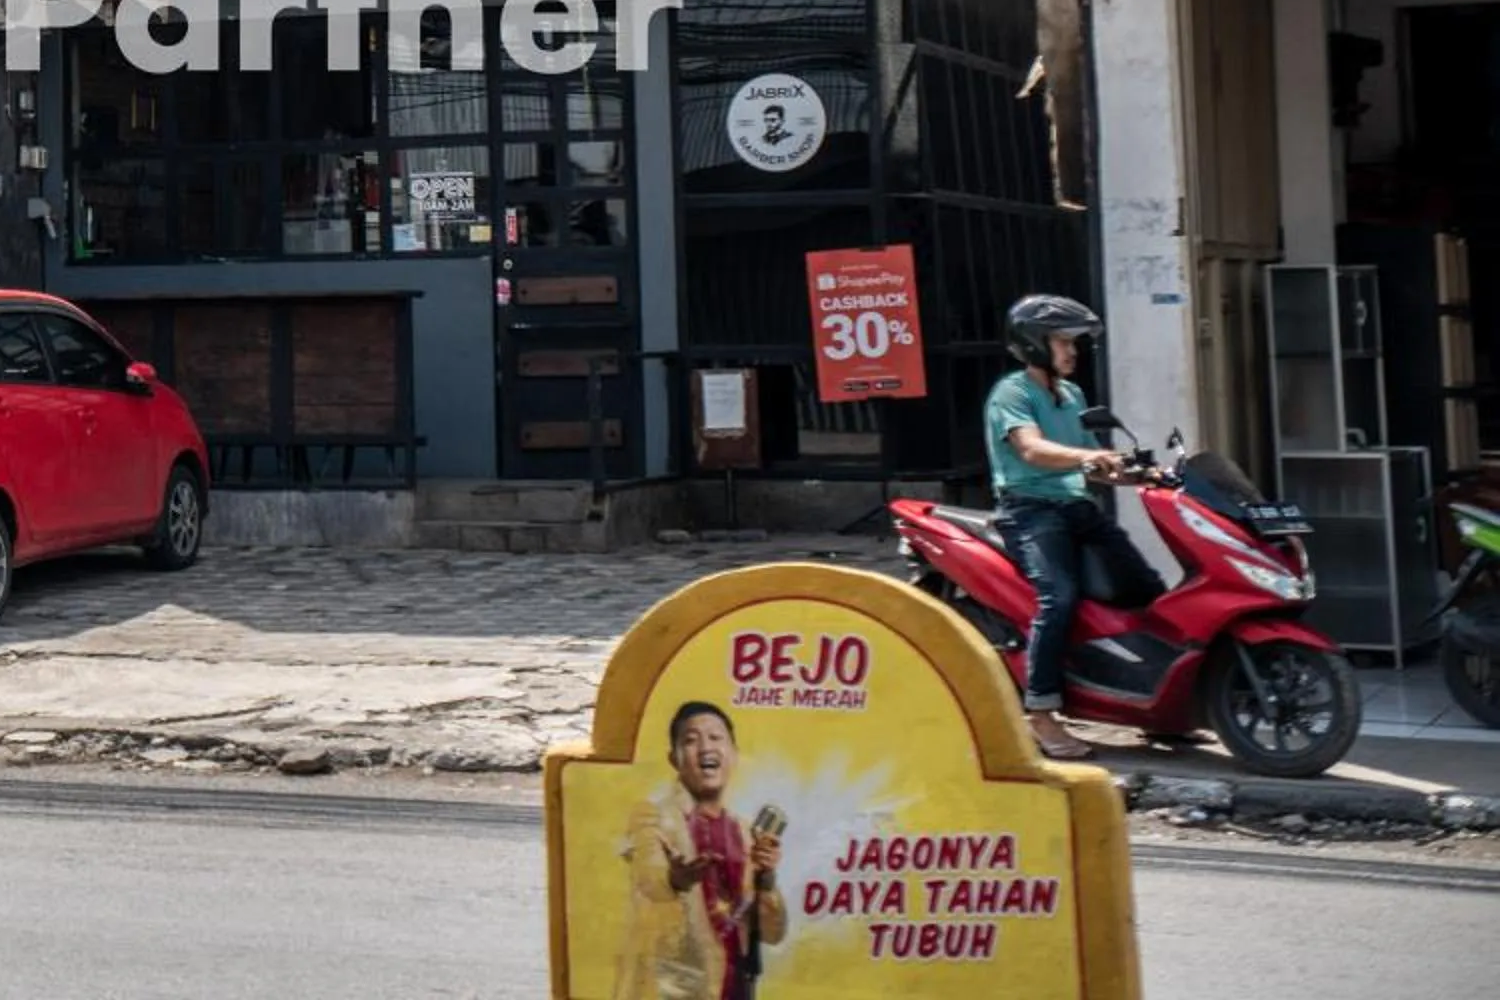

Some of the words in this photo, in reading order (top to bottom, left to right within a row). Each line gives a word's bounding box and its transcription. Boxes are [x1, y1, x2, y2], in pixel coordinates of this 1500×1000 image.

[744, 84, 806, 101] JABRIX
[410, 177, 475, 199] OPEN
[819, 292, 908, 311] CASHBACK
[821, 311, 915, 361] 30%
[732, 632, 869, 686] BEJO
[732, 686, 785, 706] JAHE
[792, 687, 867, 709] MERAH
[835, 834, 1015, 873] JAGONYA
[802, 879, 906, 916] DAYA
[924, 878, 1060, 915] TAHAN
[868, 922, 997, 959] TUBUH
